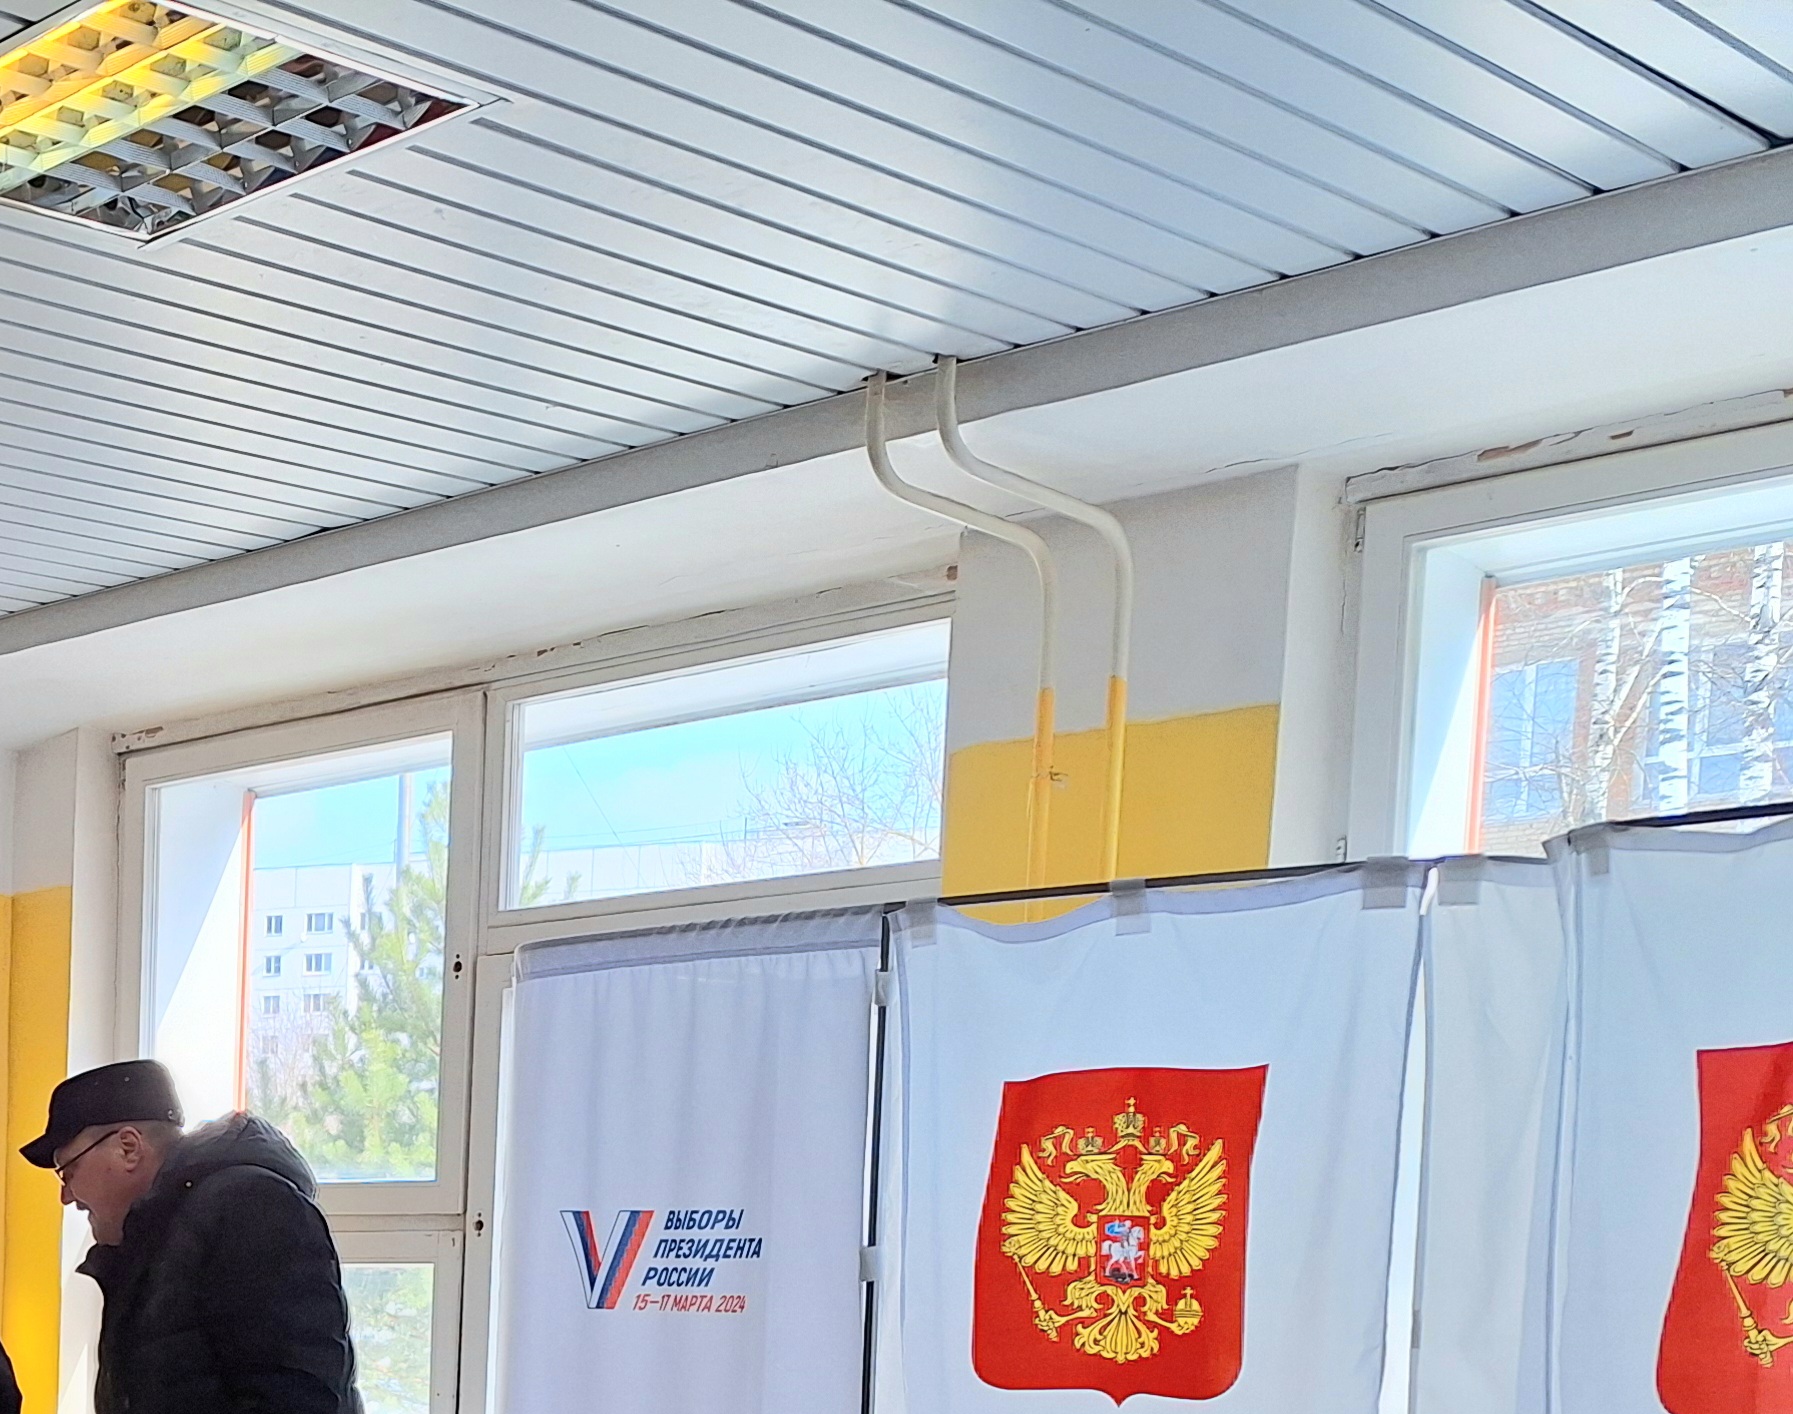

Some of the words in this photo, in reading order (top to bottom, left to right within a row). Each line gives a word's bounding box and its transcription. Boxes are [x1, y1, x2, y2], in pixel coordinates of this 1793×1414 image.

[664, 1208, 744, 1231] ВЫБОРЫ
[653, 1238, 763, 1262] ПРЕЗИДЕНТА
[641, 1267, 715, 1288] РОССИИ
[672, 1295, 713, 1312] МАРТА
[715, 1295, 746, 1313] 2024
